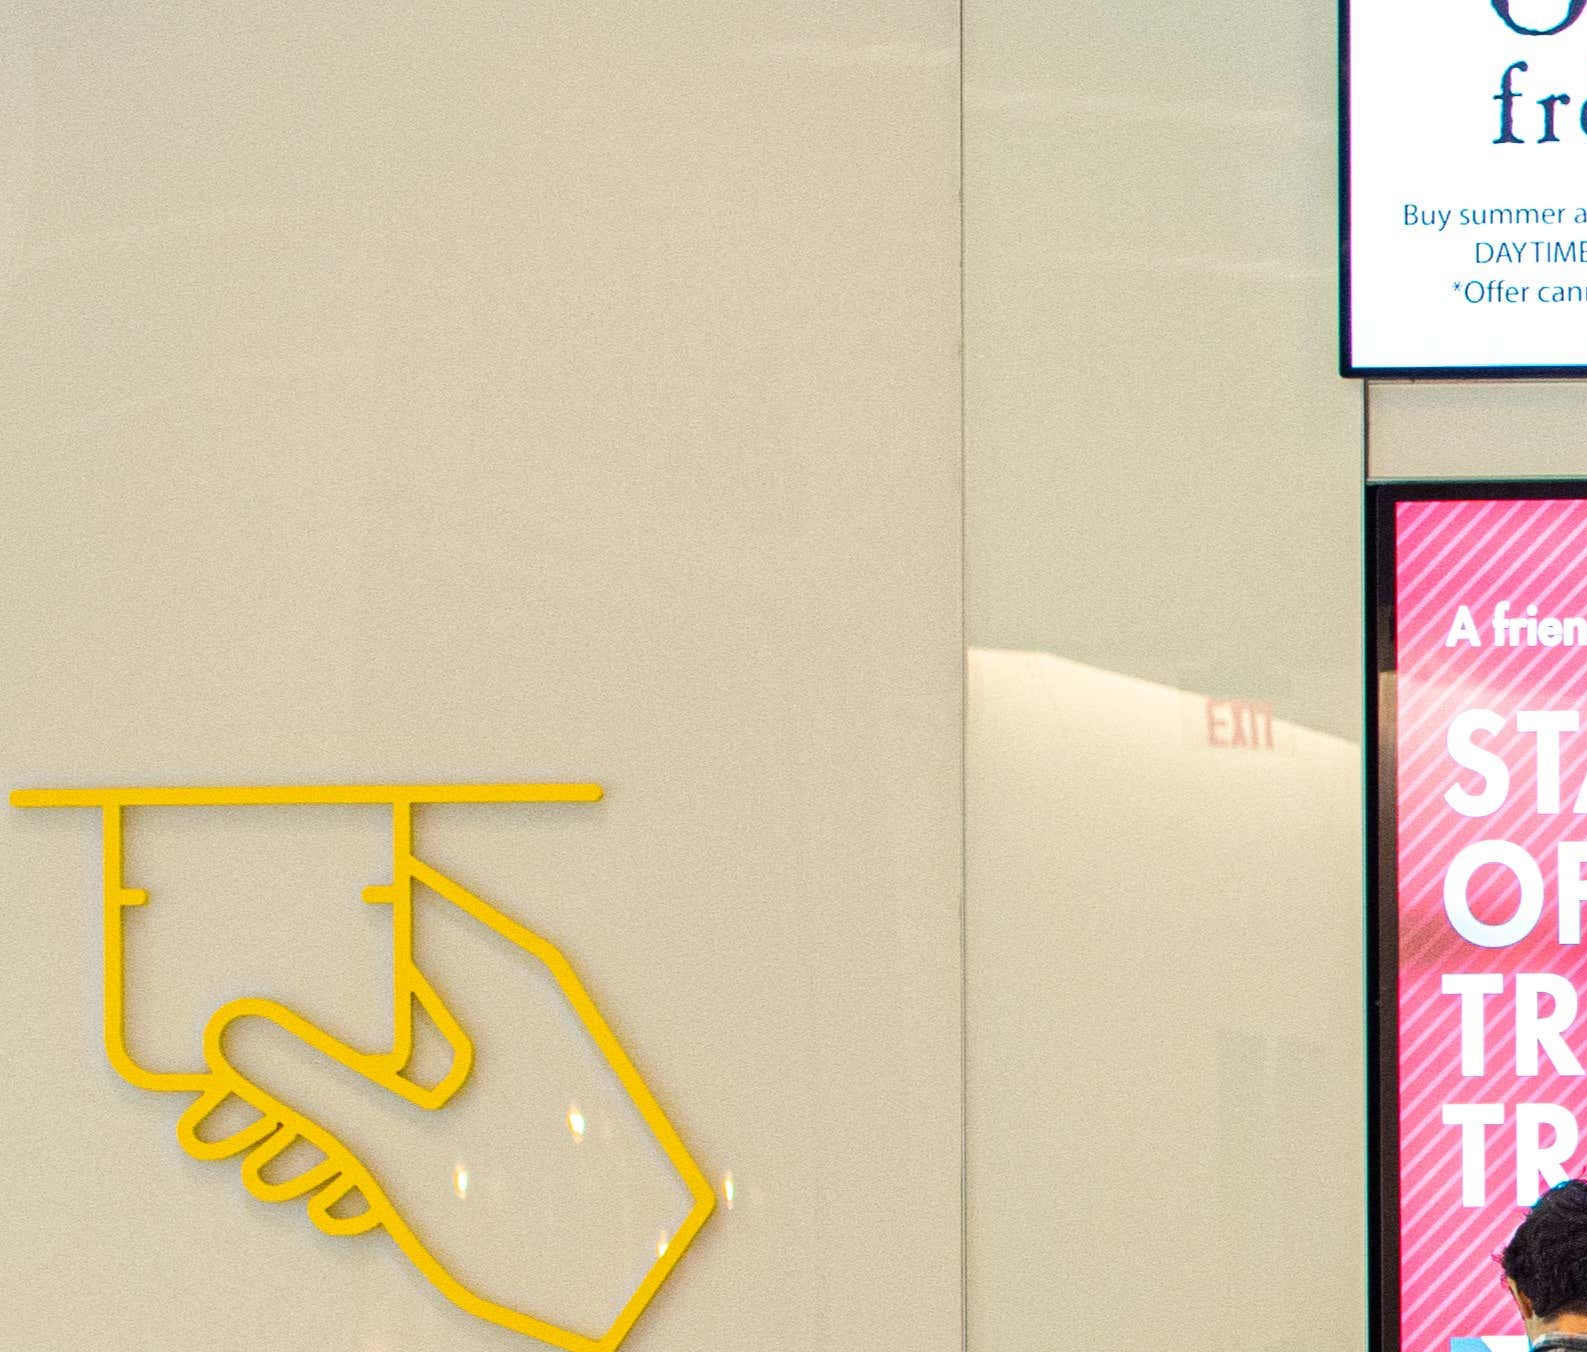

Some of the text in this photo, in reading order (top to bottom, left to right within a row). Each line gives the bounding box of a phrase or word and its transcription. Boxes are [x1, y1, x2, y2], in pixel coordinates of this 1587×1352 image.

[1405, 205, 1451, 231] Buy
[1460, 209, 1565, 225] summer
[1446, 605, 1481, 647] A
